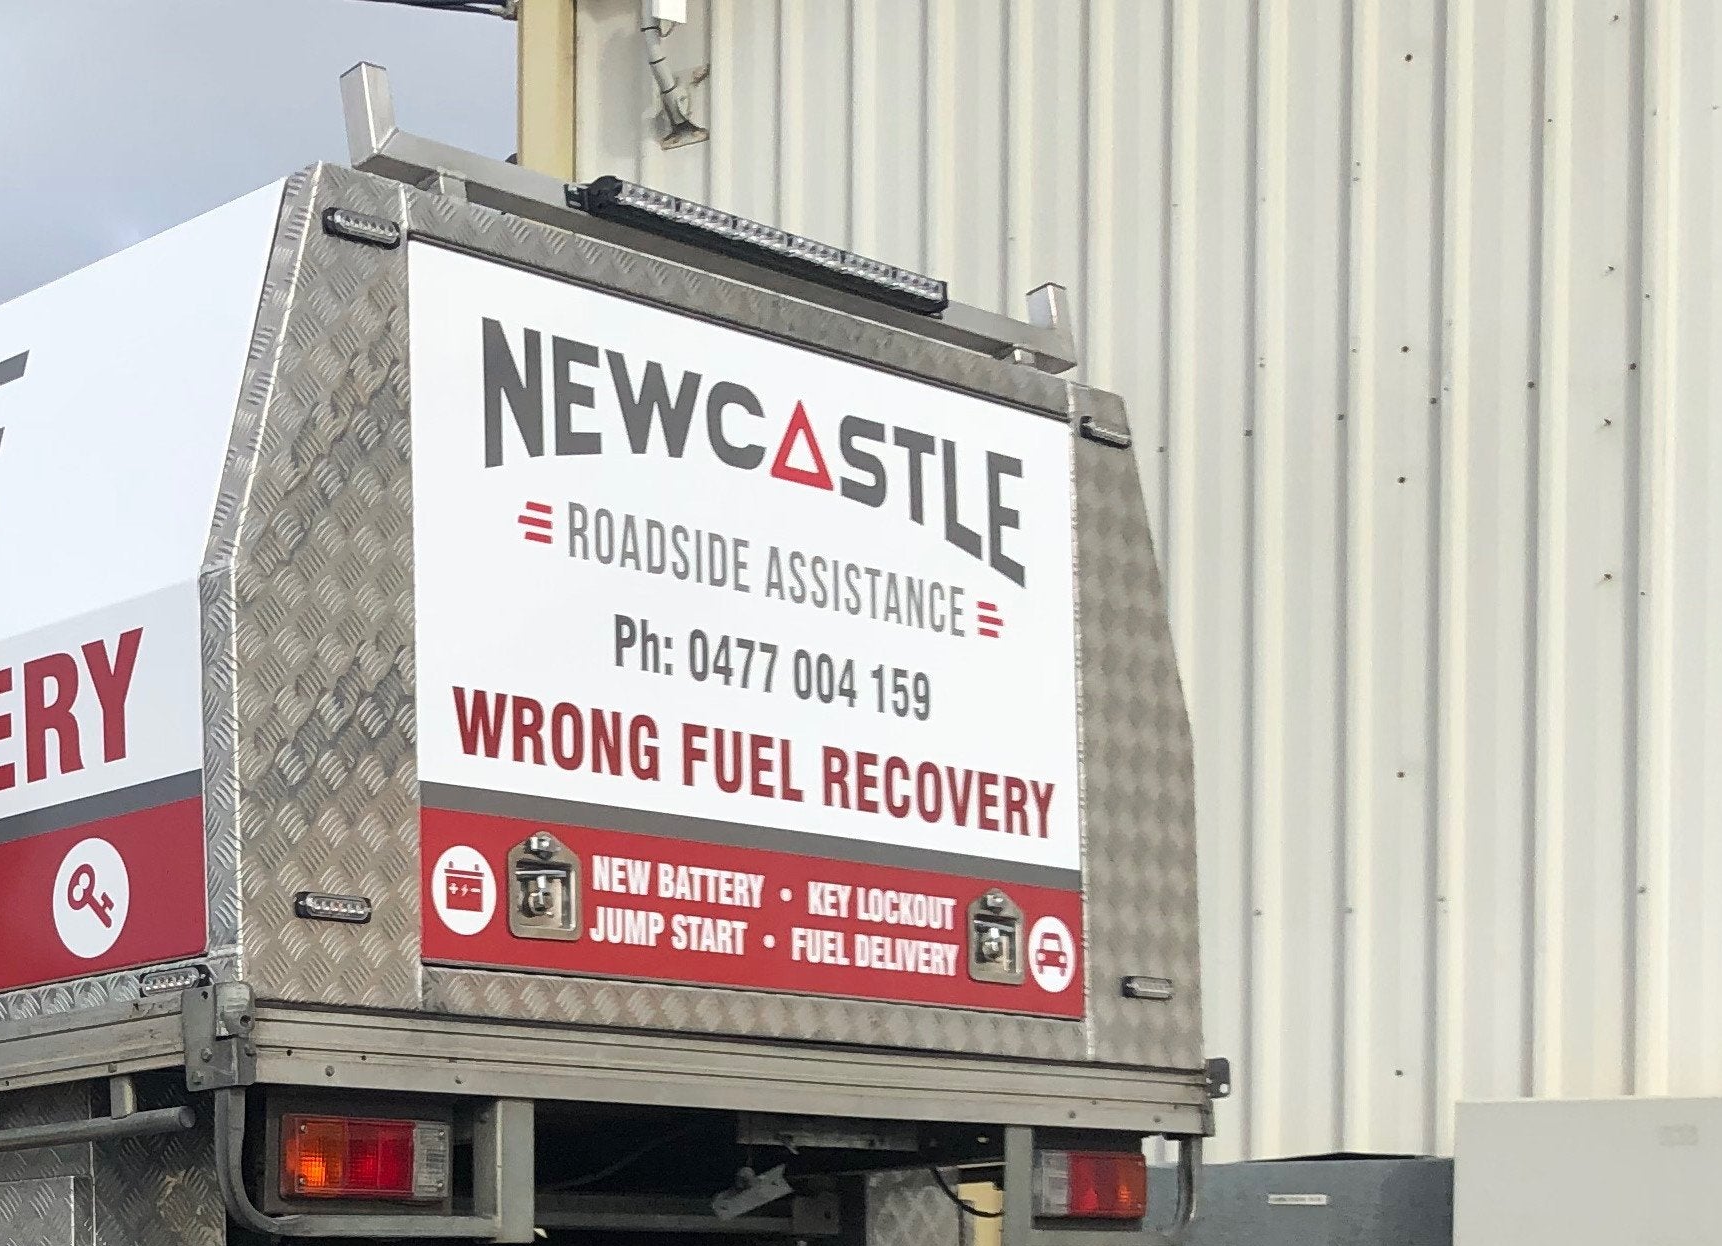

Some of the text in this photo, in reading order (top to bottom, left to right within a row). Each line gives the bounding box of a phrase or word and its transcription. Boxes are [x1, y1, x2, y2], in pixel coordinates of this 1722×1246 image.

[481, 315, 1026, 588] NEWCASTLE
[567, 502, 966, 638] ROADSIDE ASSISTANCE
[614, 613, 932, 721] Ph: 0477 004 159
[452, 685, 1056, 840] WRONG FUEL RECOVERY
[589, 905, 959, 976] JUMP START FUEL DELIVERY
[591, 854, 957, 930] NEW BATTERY KEY LOCKOUT
